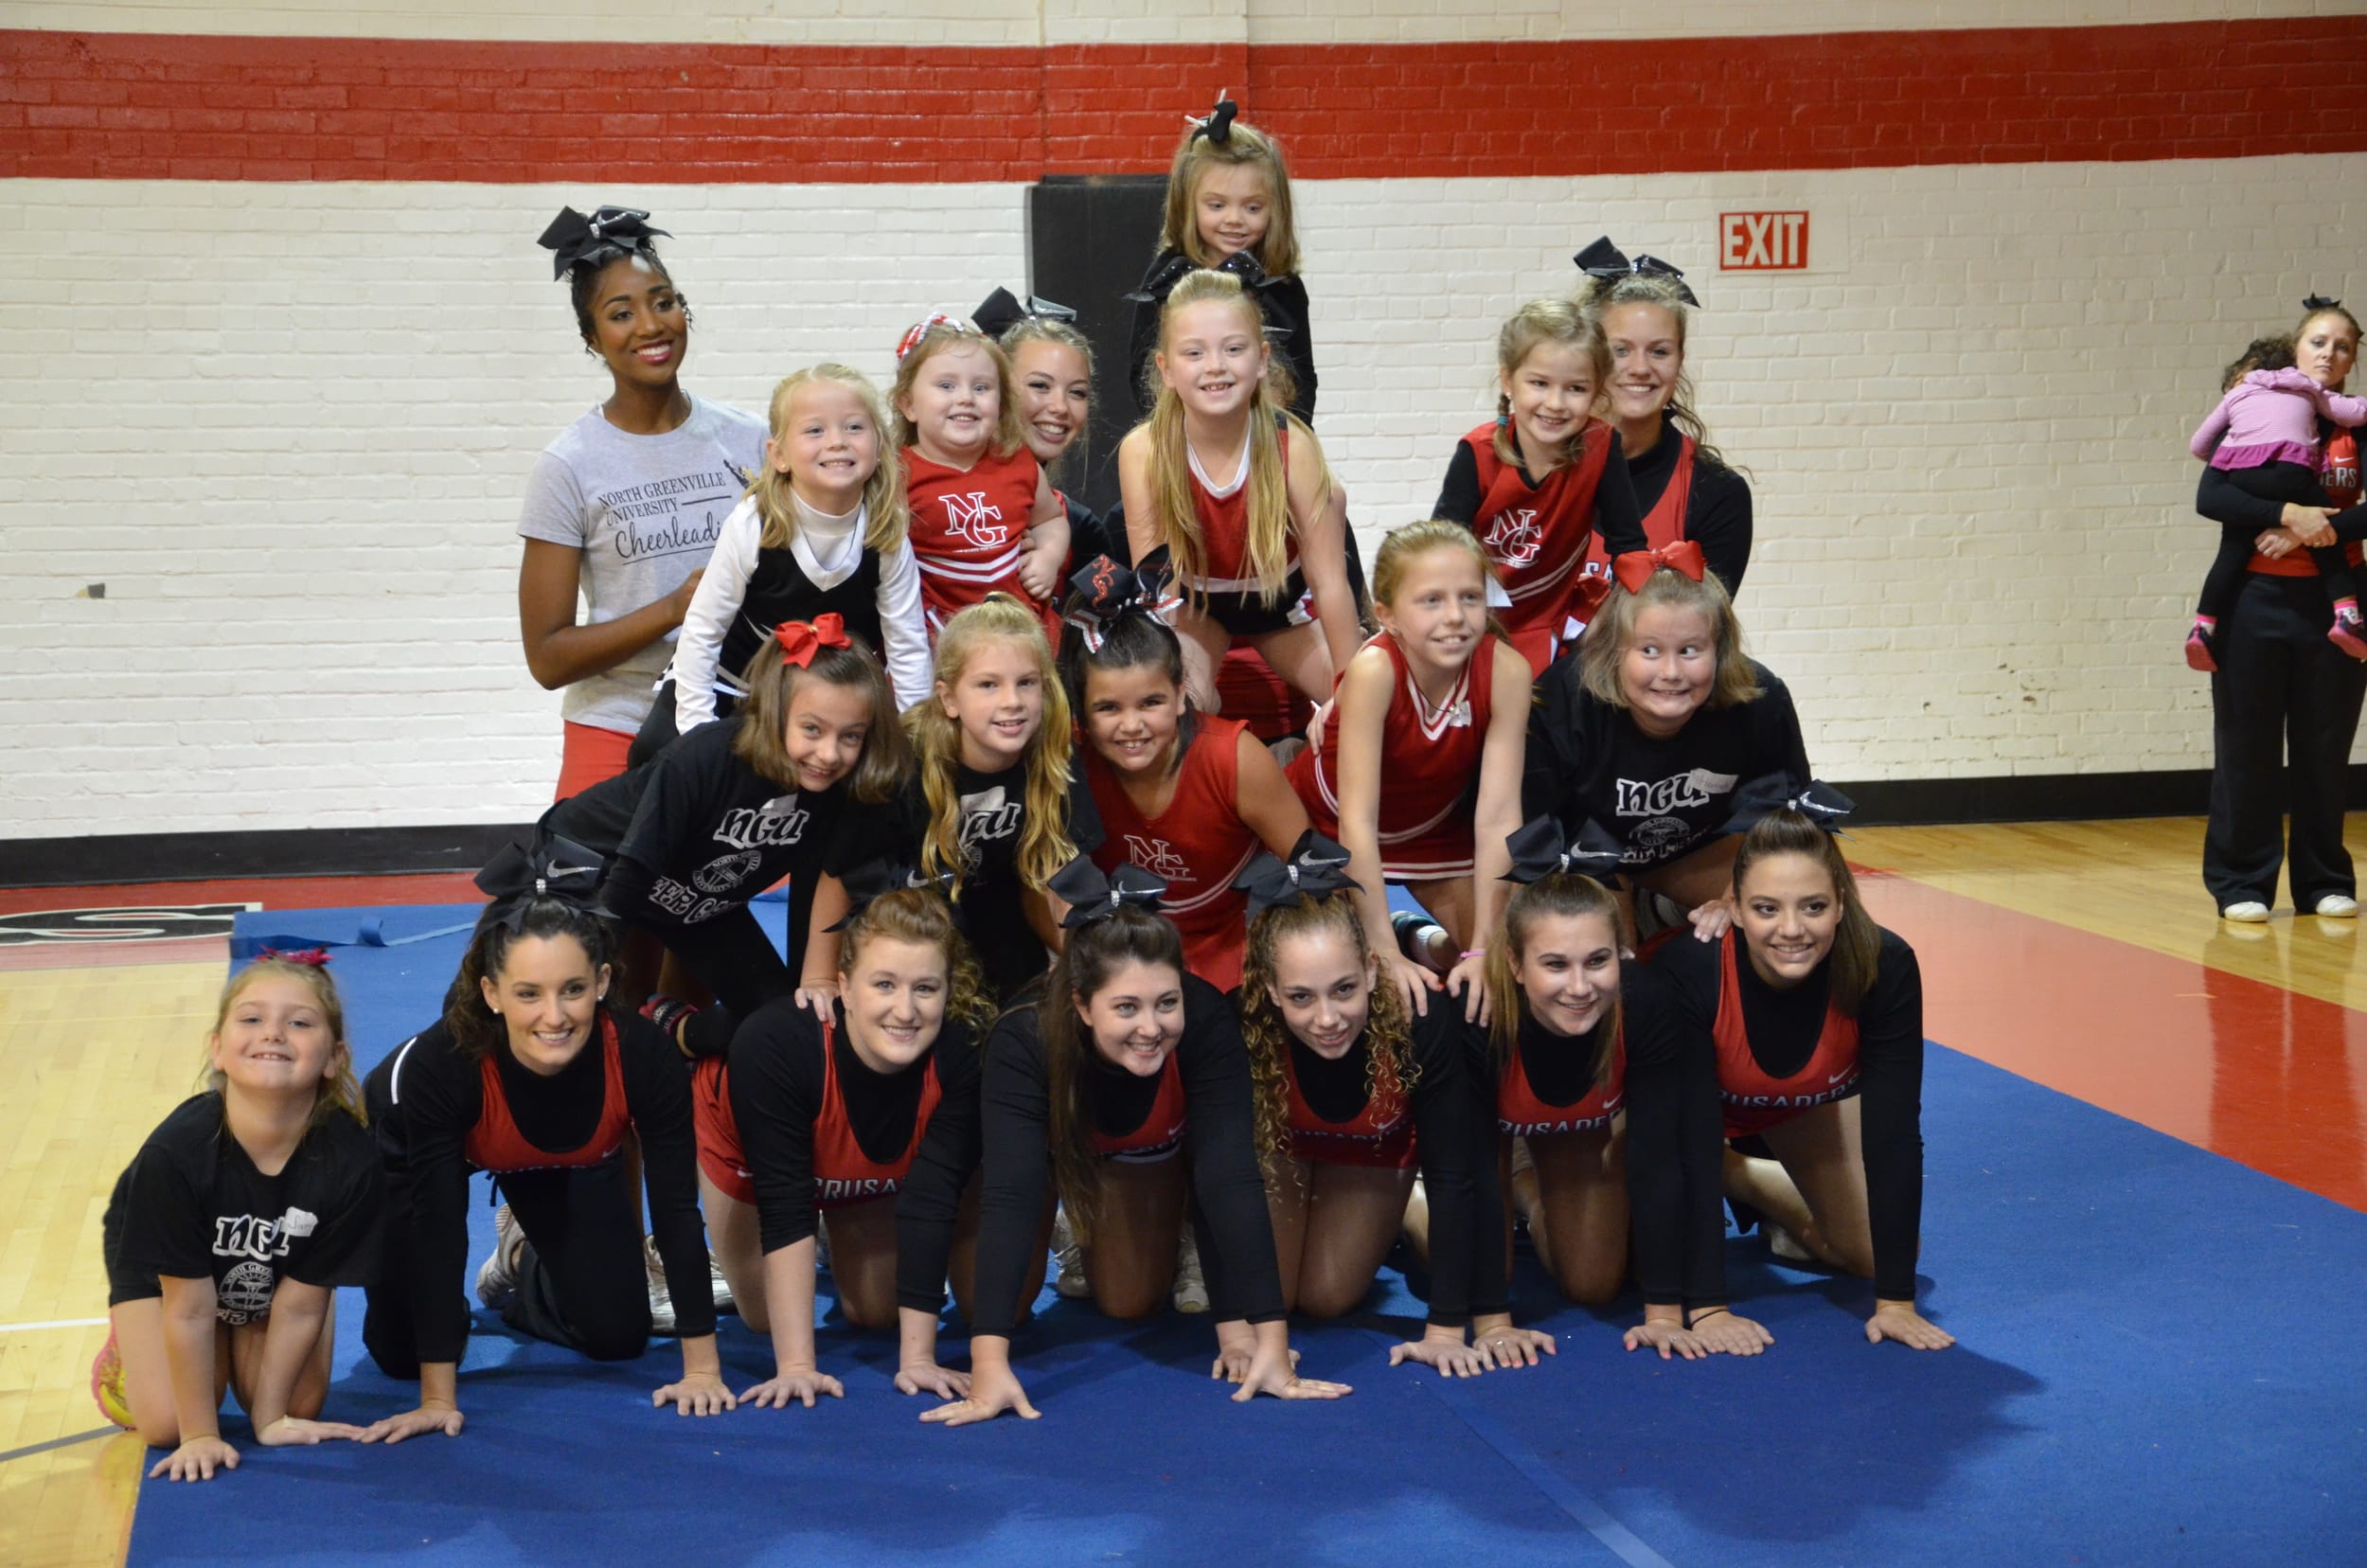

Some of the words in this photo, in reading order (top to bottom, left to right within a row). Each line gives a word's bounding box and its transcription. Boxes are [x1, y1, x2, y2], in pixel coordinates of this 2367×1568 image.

[1723, 214, 1805, 266] EXIT
[596, 486, 644, 509] NORTH
[643, 472, 726, 497] GREENVILLE
[606, 497, 680, 526] UNIVERSITY
[938, 491, 1007, 547] NG
[1483, 508, 1542, 561] NG
